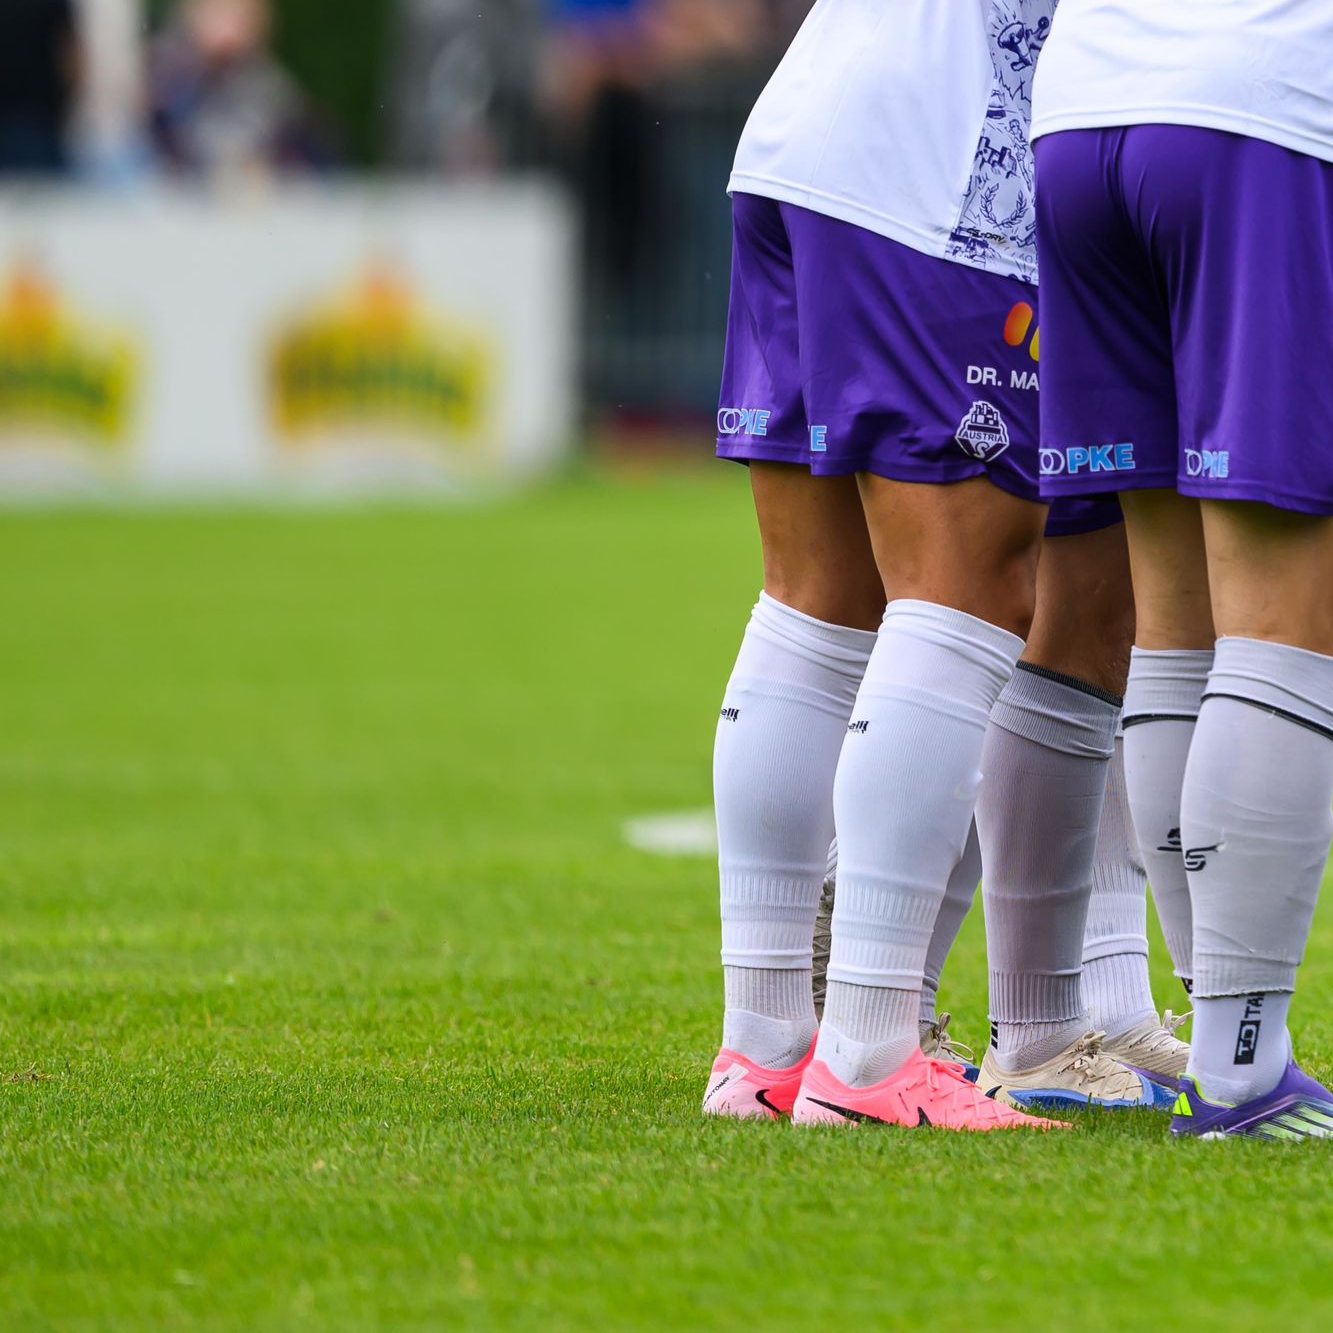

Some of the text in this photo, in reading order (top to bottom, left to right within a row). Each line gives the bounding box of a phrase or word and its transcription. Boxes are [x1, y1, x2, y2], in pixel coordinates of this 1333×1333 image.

[966, 365, 1040, 391] DR. MA
[962, 430, 1005, 443] AUSTRIA
[1066, 442, 1136, 474] PKE
